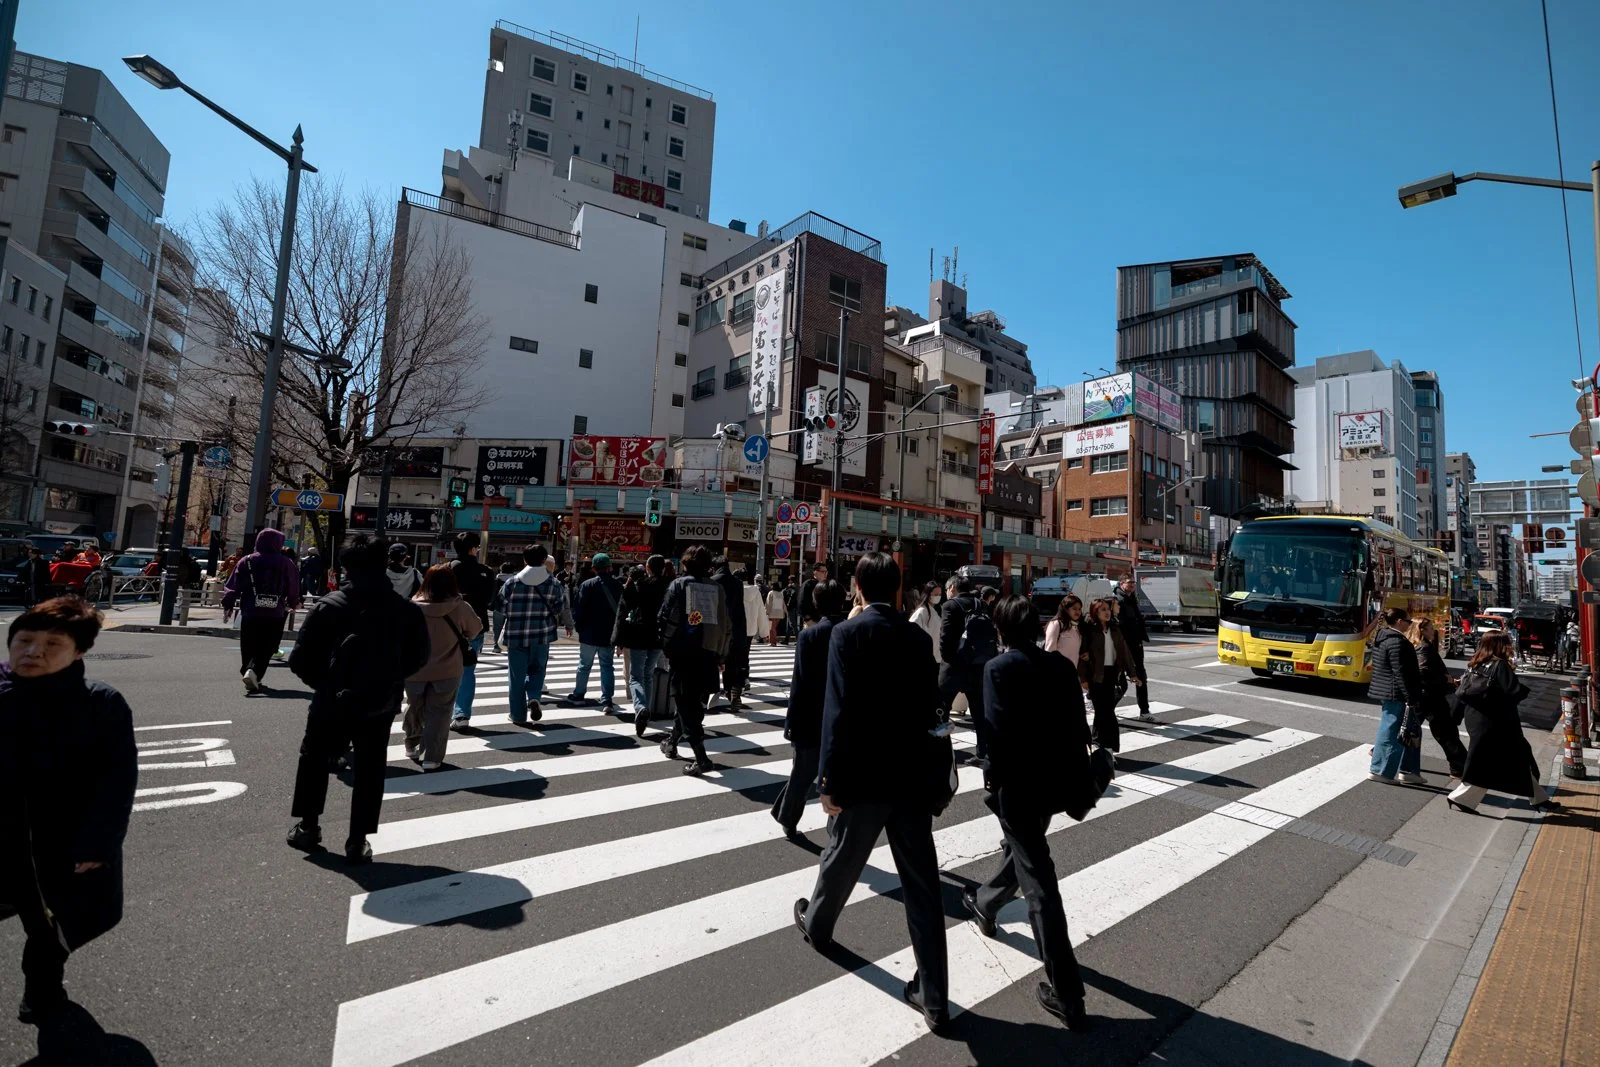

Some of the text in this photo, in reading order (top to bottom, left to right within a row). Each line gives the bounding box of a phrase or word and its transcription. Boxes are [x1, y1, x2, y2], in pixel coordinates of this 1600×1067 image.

[752, 330, 767, 408] 富士そば
[1095, 382, 1131, 396] アドバンス
[1077, 427, 1114, 442] 広告募集
[1342, 426, 1381, 437] アミューズ
[498, 449, 538, 458] 写真プリント
[1076, 443, 1115, 455] 03-5774-7506
[497, 461, 525, 470] 証明写真
[618, 440, 628, 485] KEBAB
[628, 441, 640, 484] ケバブ
[299, 495, 320, 506] 463
[680, 526, 719, 536] SMOCO
